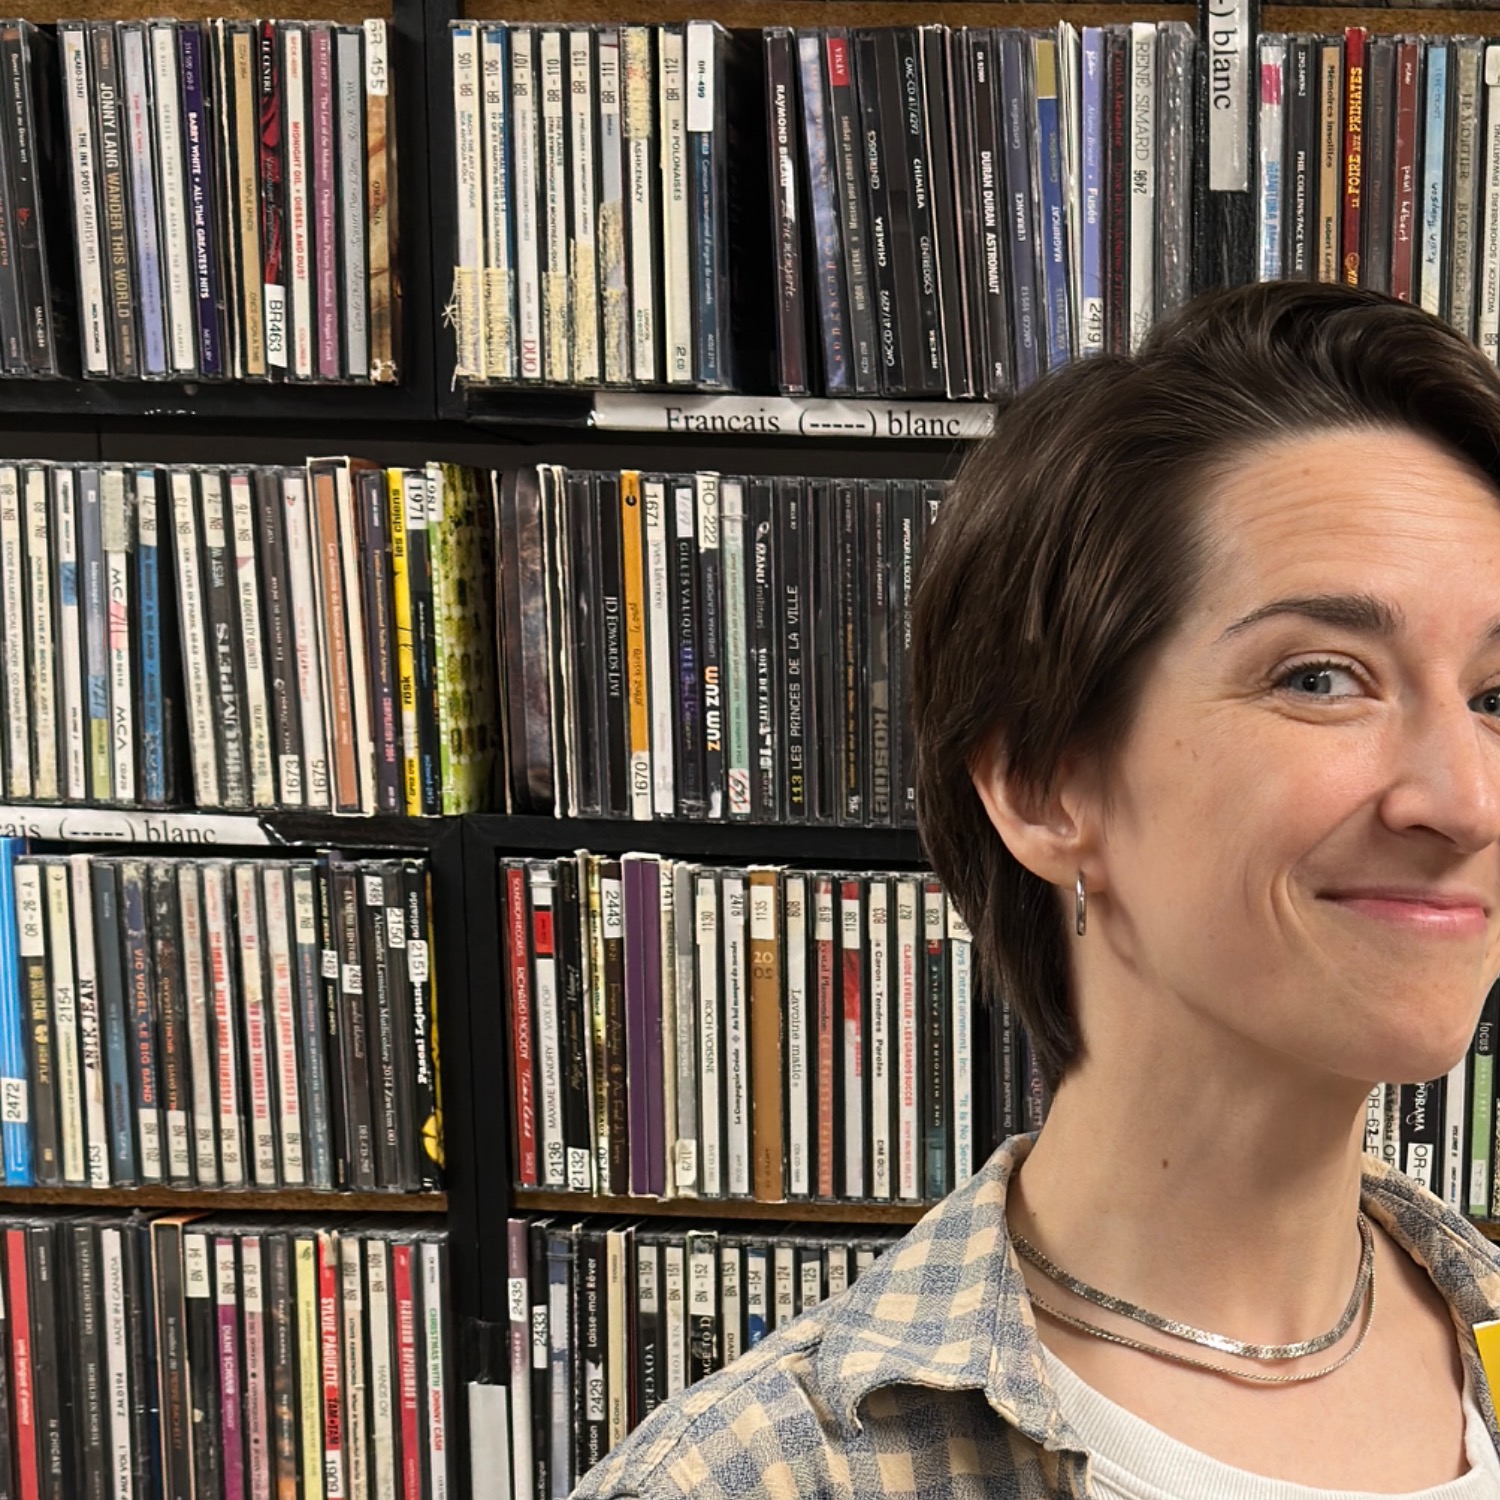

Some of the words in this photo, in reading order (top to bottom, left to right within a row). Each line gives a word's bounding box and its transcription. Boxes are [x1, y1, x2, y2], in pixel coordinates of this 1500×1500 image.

[1134, 41, 1150, 89] RENÉ
[1212, 29, 1235, 110] blanc
[1134, 94, 1150, 161] SIMARD
[633, 140, 642, 203] ASHKENAZY
[268, 300, 282, 352] BR463
[1087, 303, 1101, 343] 2419
[522, 340, 536, 372] DUO
[887, 410, 960, 437] blanc
[407, 484, 423, 522] 1971
[702, 479, 716, 544] RO-222
[633, 761, 645, 798] 1670
[144, 820, 216, 843] blanc
[605, 890, 619, 927] 2443
[411, 942, 424, 978] 2151
